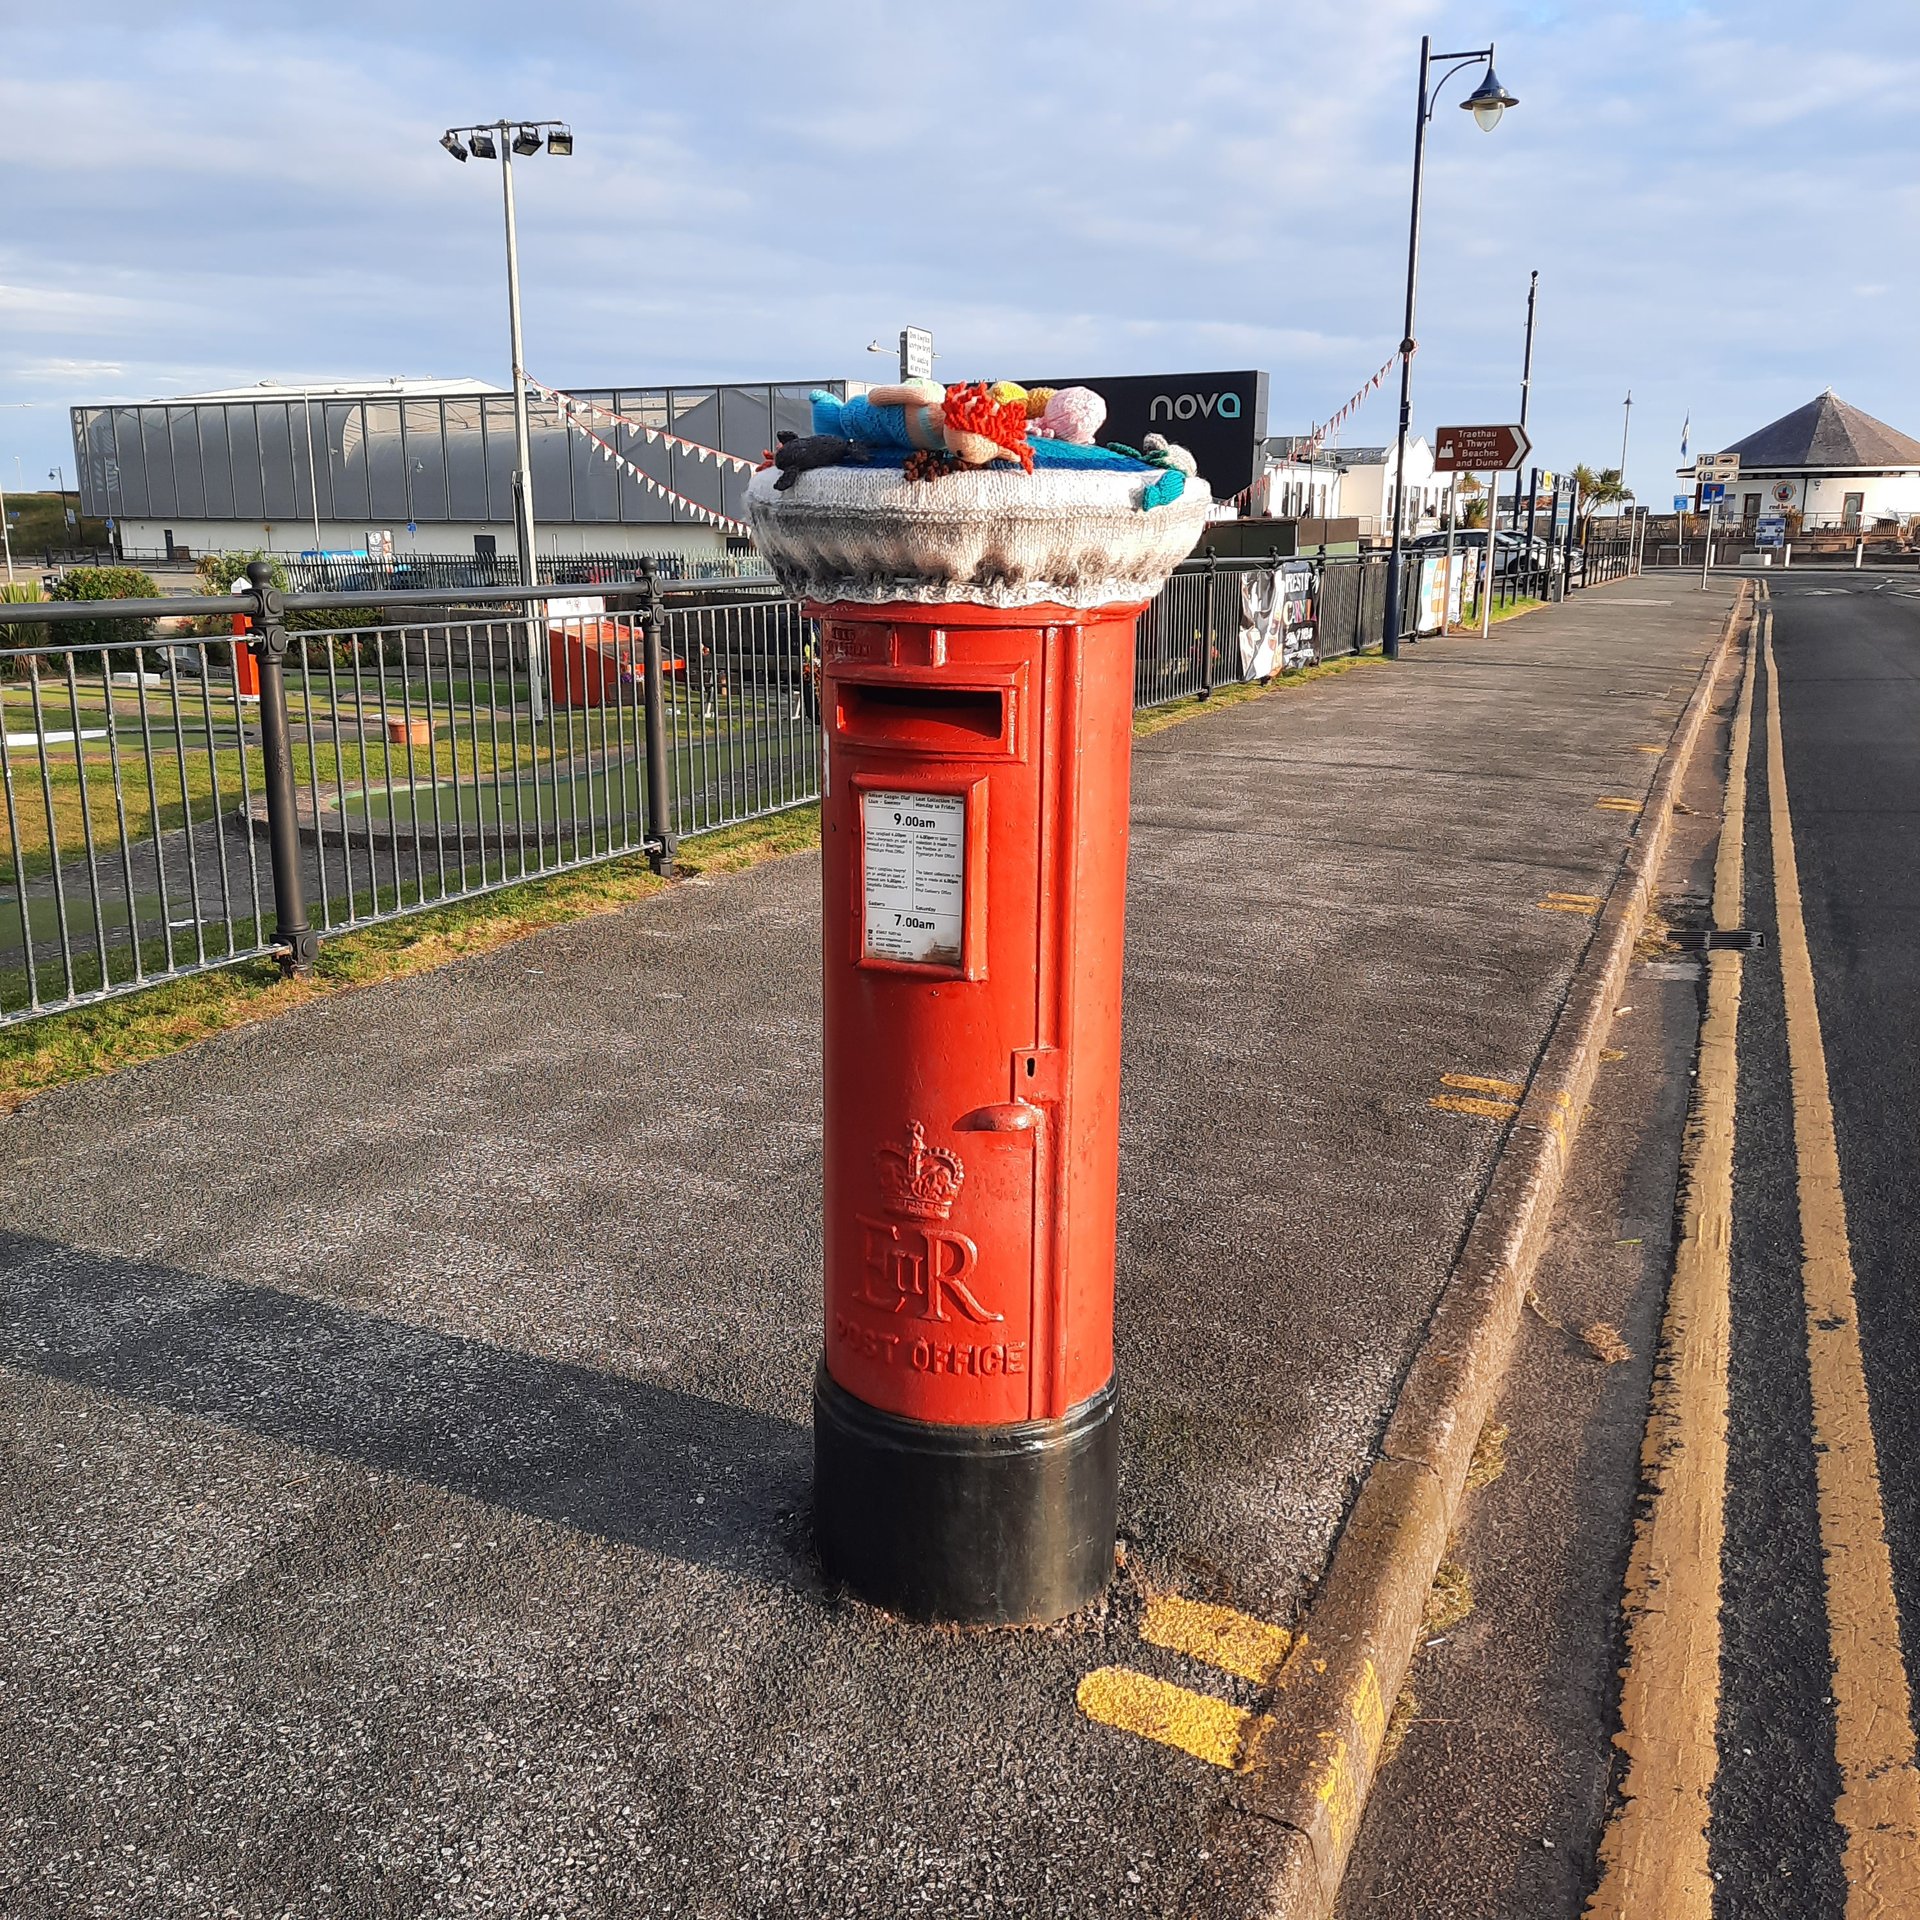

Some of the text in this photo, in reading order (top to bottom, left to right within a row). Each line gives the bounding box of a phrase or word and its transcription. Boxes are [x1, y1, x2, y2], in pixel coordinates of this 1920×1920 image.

[1149, 392, 1241, 421] nova
[1458, 430, 1497, 438] Traethau
[1462, 449, 1499, 457] Beaches
[1456, 459, 1473, 467] and
[1706, 457, 1713, 465] P
[893, 813, 936, 829] 9.00am
[894, 914, 935, 930] 7.00am
[911, 1336, 1026, 1376] OFFICE
